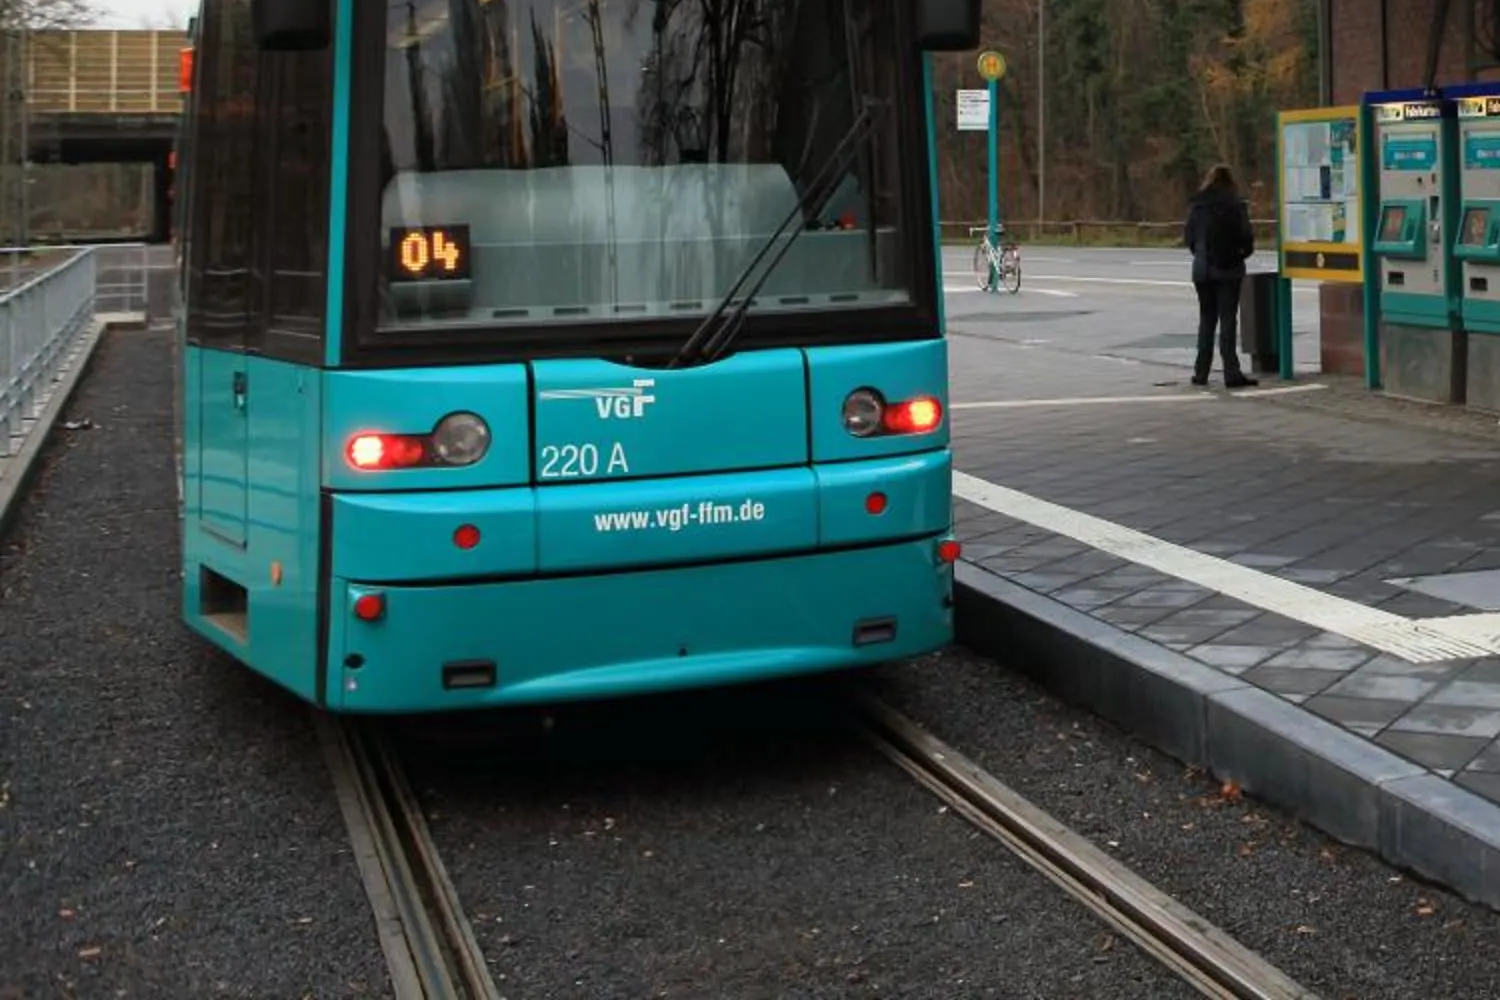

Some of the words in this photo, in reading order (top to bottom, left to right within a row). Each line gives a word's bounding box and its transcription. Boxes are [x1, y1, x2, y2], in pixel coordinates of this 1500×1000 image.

[401, 231, 459, 271] 04
[595, 379, 655, 419] VGF
[541, 443, 599, 477] 220
[607, 441, 629, 473] A
[594, 498, 765, 532] www.vgf-ffm.de
